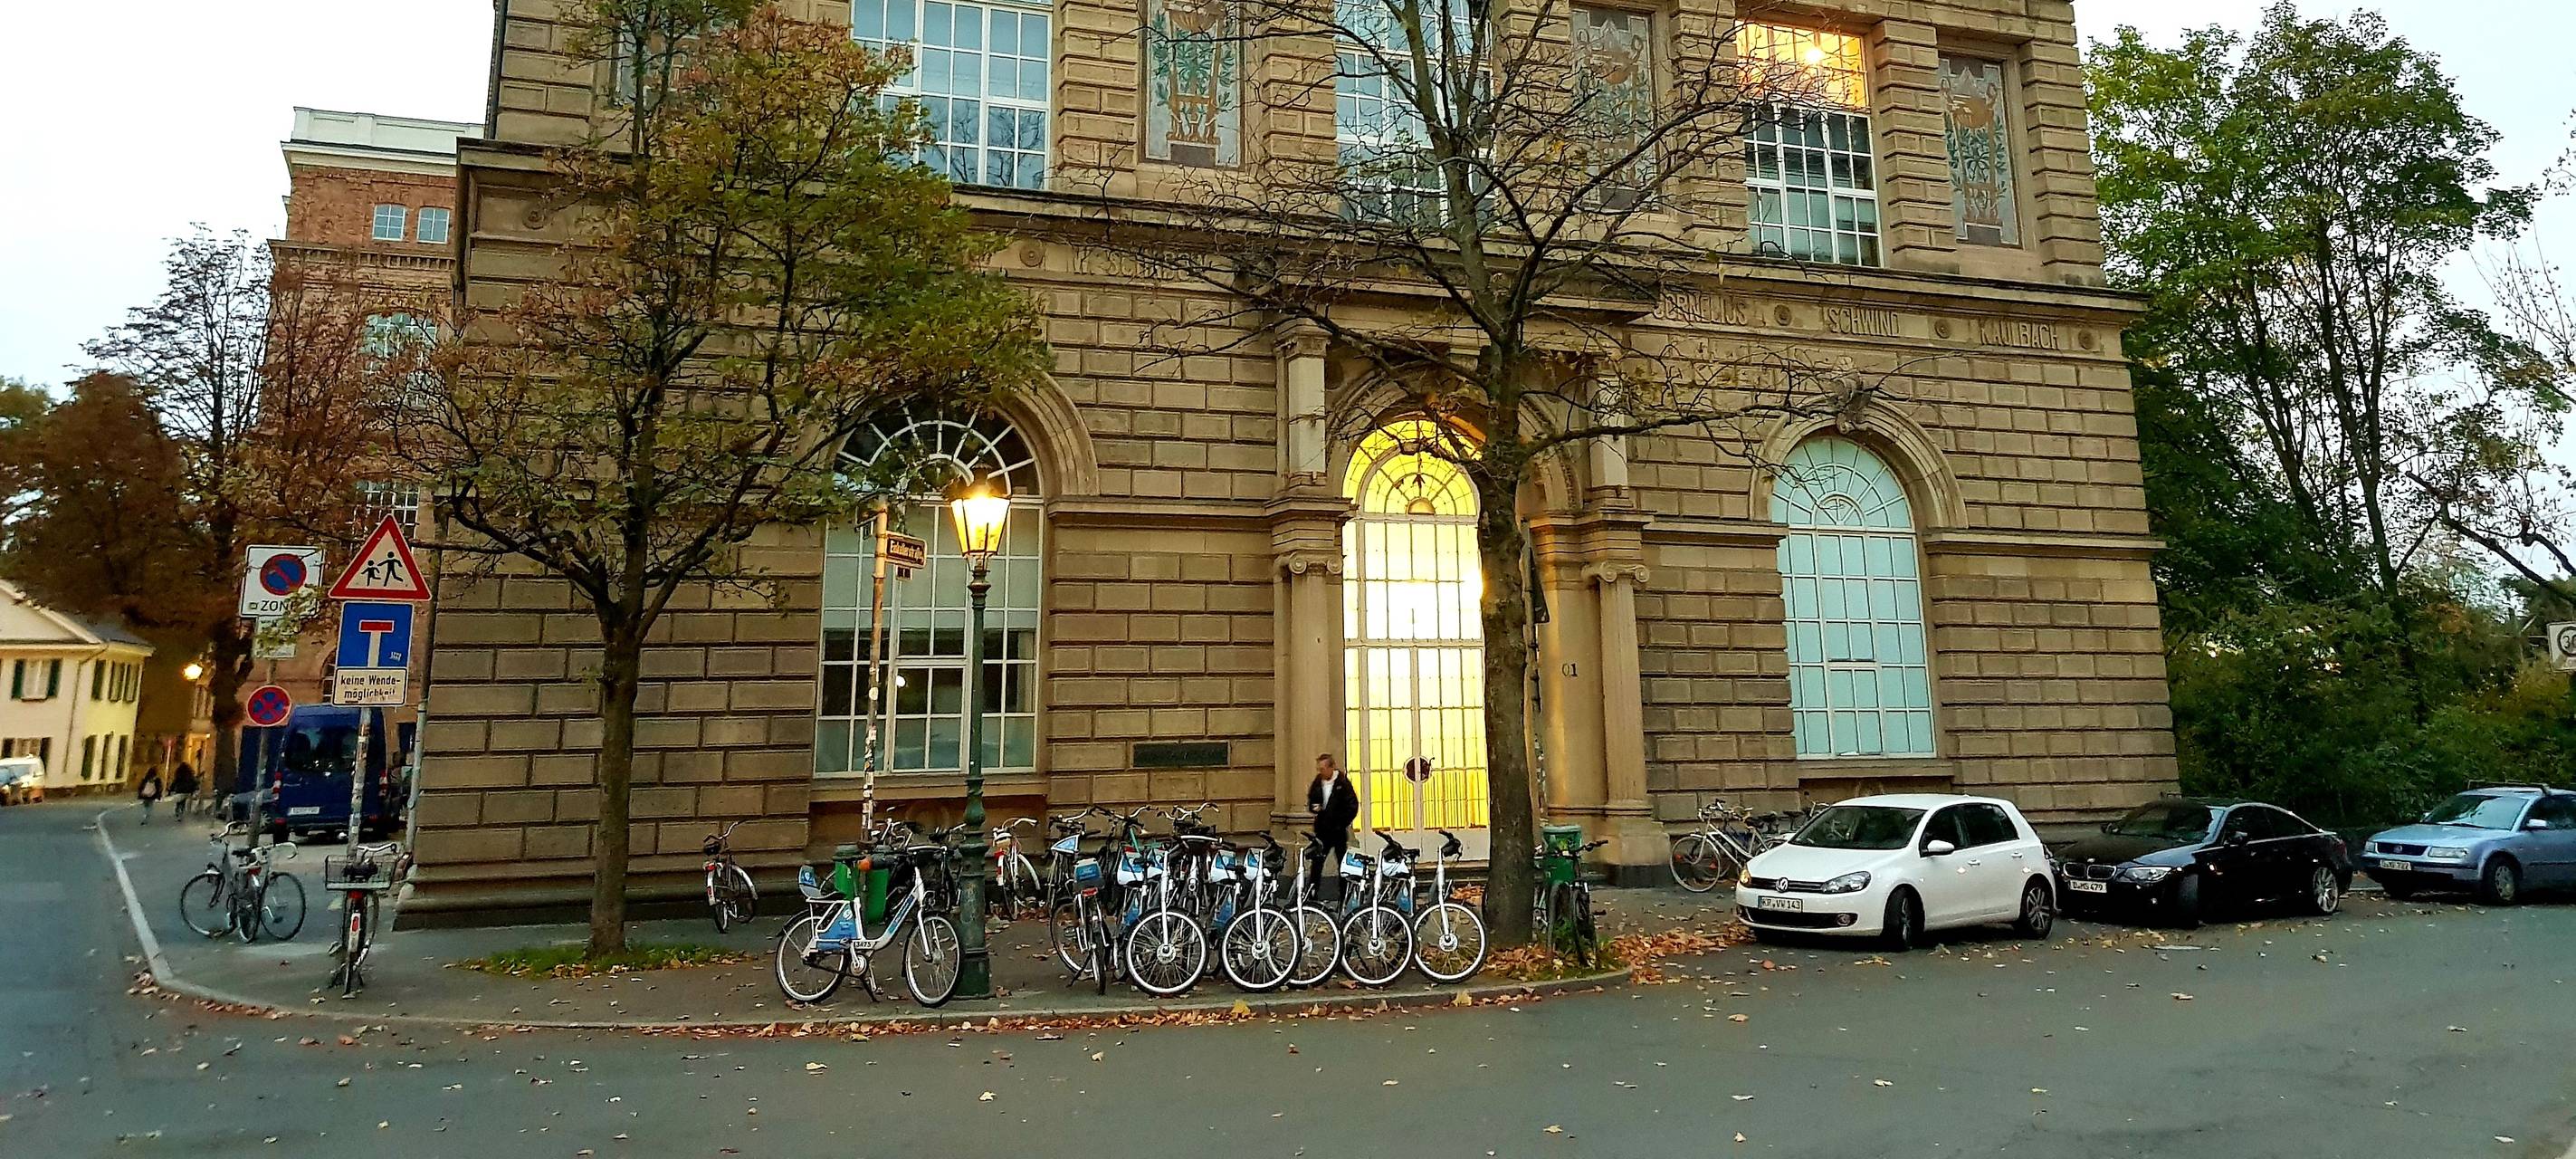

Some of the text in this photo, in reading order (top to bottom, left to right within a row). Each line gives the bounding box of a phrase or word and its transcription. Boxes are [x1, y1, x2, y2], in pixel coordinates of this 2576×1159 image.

[1828, 306, 1900, 338] SCHWIND
[340, 675, 401, 685] keine Wende-
